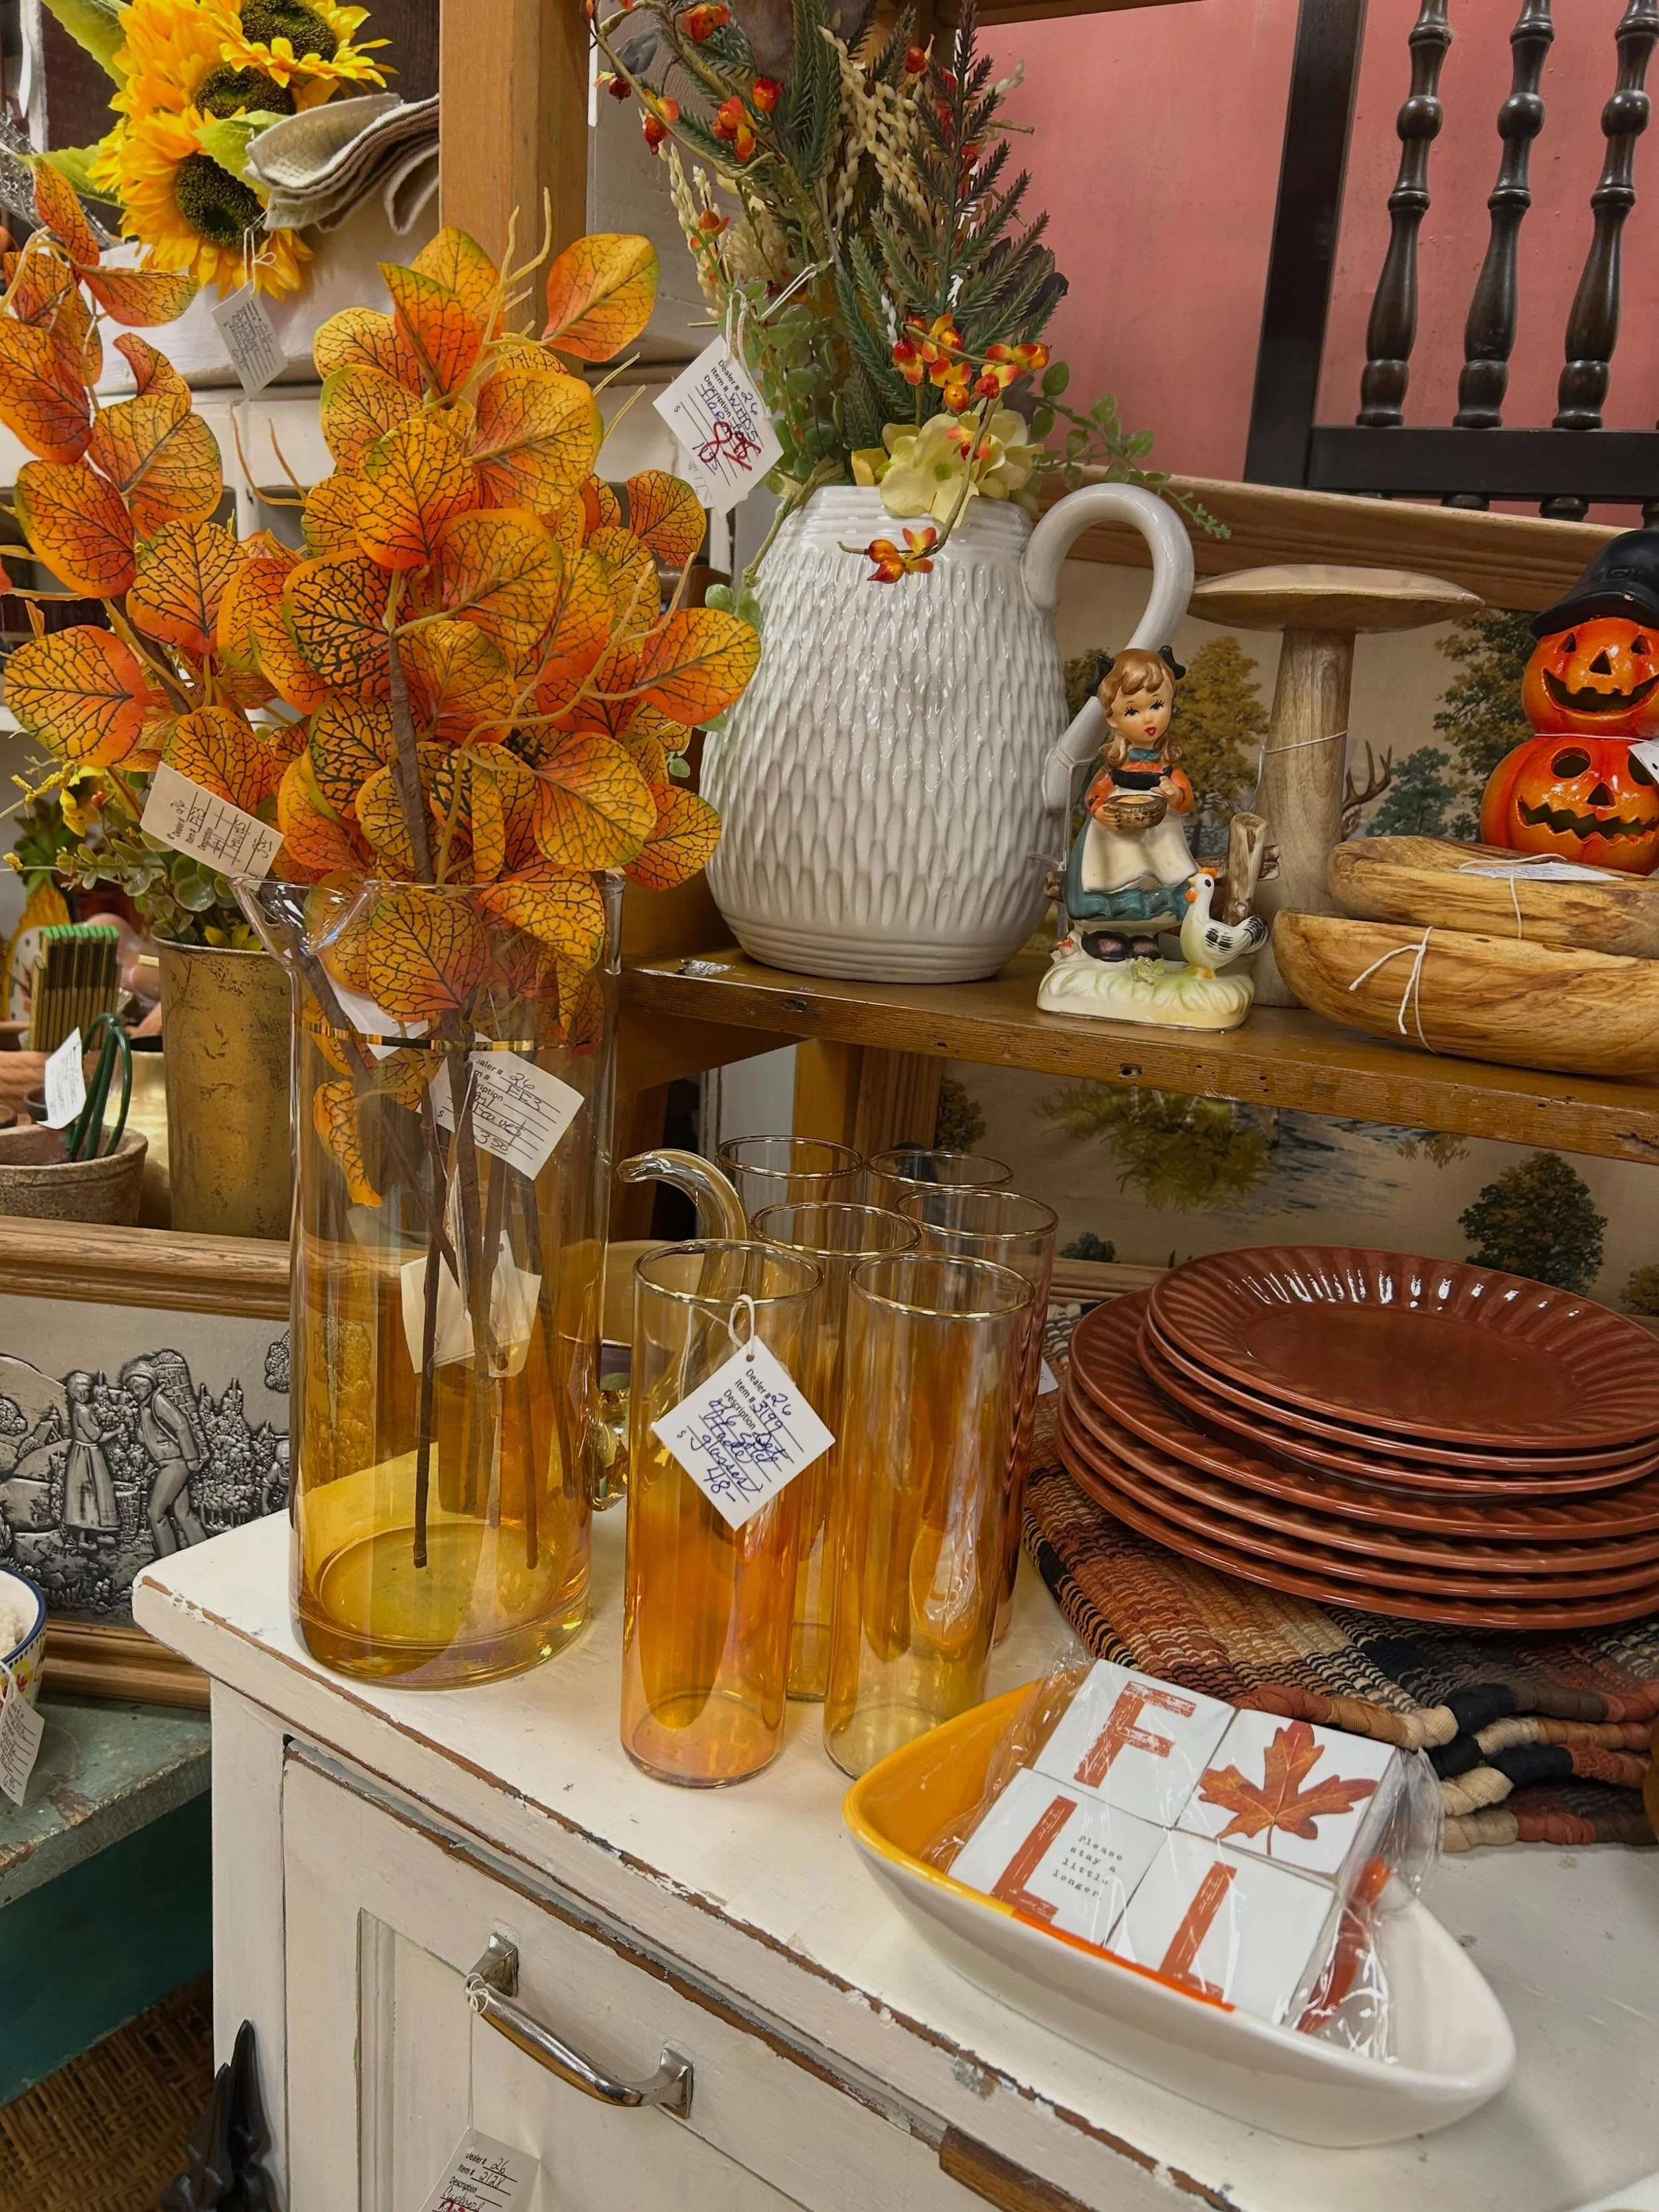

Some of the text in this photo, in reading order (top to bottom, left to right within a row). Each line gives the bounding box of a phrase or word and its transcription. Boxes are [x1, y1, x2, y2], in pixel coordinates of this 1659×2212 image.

[711, 367, 724, 388] Item
[718, 360, 737, 385] Dealer
[741, 392, 758, 415] 26
[704, 375, 732, 418] Description
[172, 821, 184, 838] Dealer
[197, 827, 214, 851] Description
[476, 1059, 496, 1072] aler
[510, 1072, 536, 1089] 26
[477, 1083, 504, 1102] ription
[745, 1368, 766, 1394] Dealer
[771, 1392, 792, 1416] 26
[723, 1388, 756, 1431] Description
[735, 1378, 751, 1398] Item
[753, 1400, 783, 1433] 3199
[677, 1430, 687, 1439] $
[1072, 1680, 1196, 1789] F
[1070, 1846, 1101, 1865] stay
[1078, 1835, 1123, 1862] Please
[457, 2164, 470, 2175] Item
[479, 2171, 506, 2189] 2128
[490, 2158, 510, 2174] 26
[449, 2175, 478, 2194] Description
